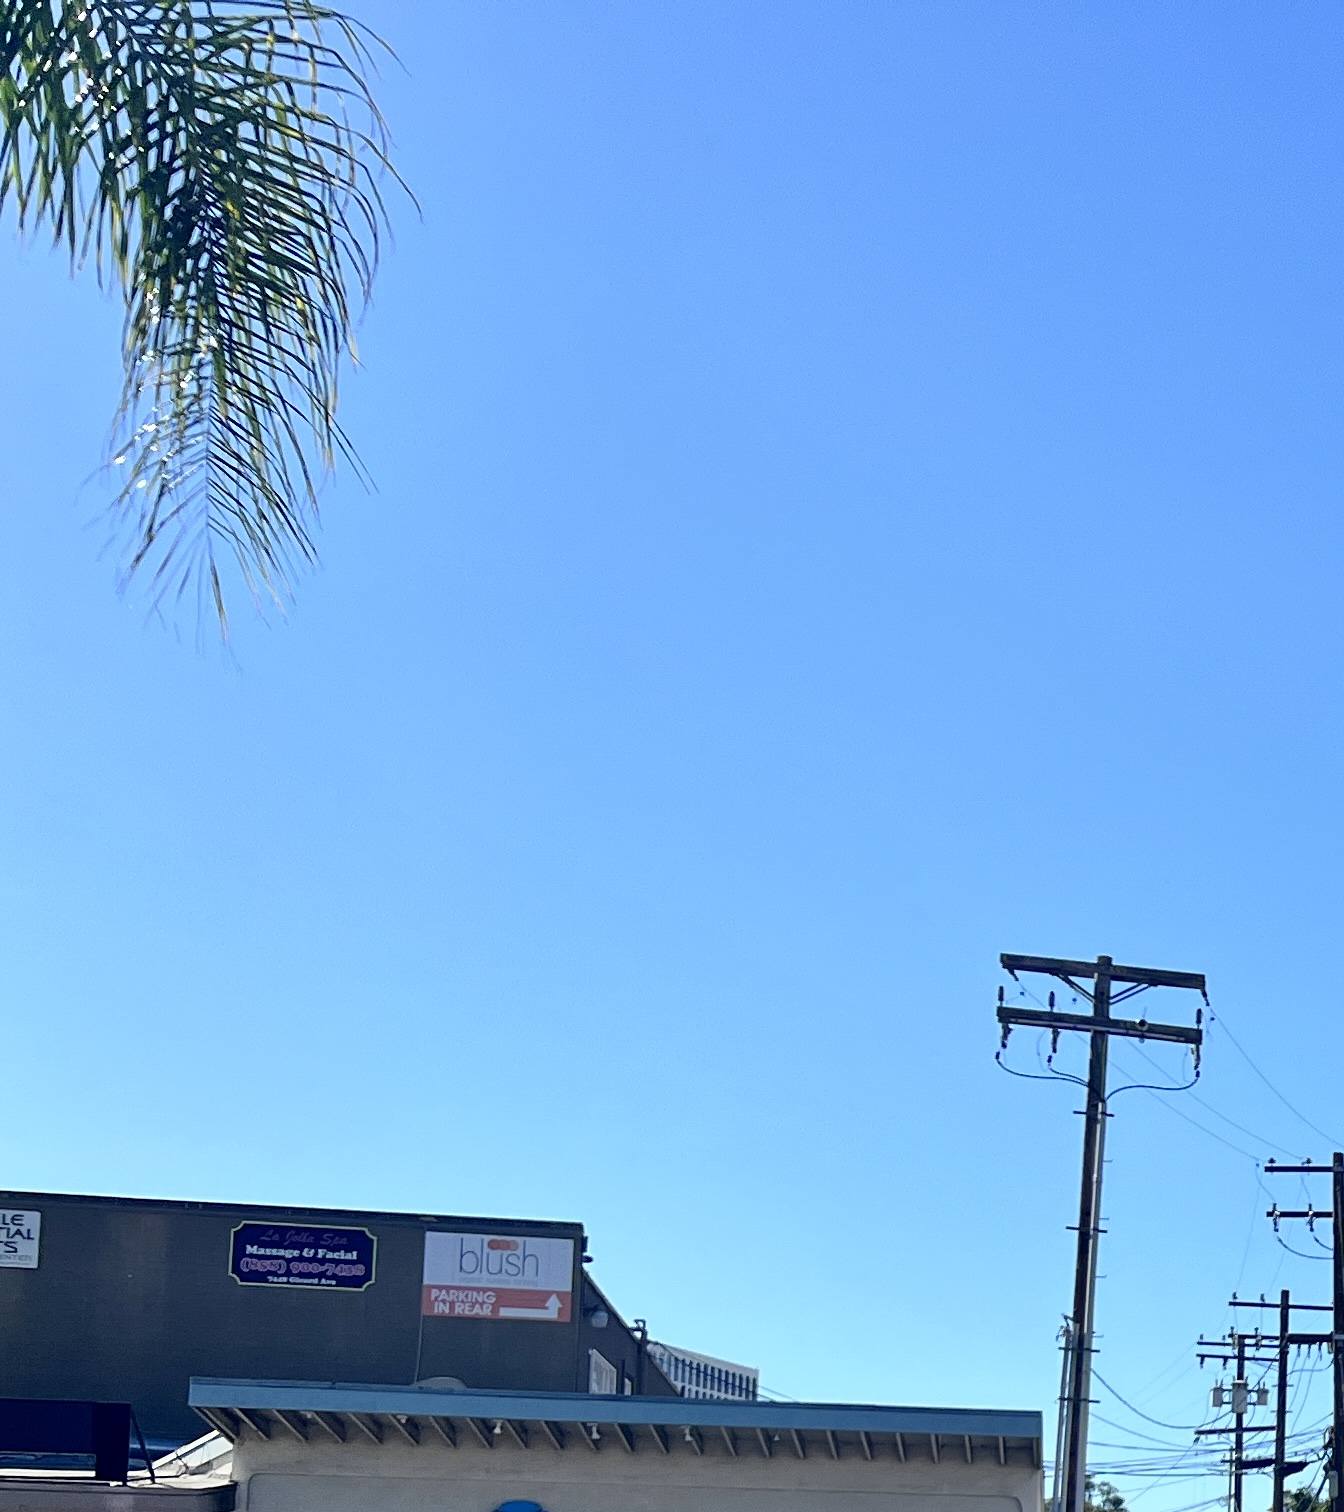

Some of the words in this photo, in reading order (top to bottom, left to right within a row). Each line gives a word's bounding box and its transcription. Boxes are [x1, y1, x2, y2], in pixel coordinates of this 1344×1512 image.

[246, 1244, 300, 1258] Massage
[302, 1247, 314, 1257] &
[316, 1249, 358, 1260] Facial
[459, 1237, 540, 1277] blush
[430, 1289, 497, 1303] PARKING
[433, 1301, 450, 1314] IN
[455, 1302, 493, 1316] REAR
